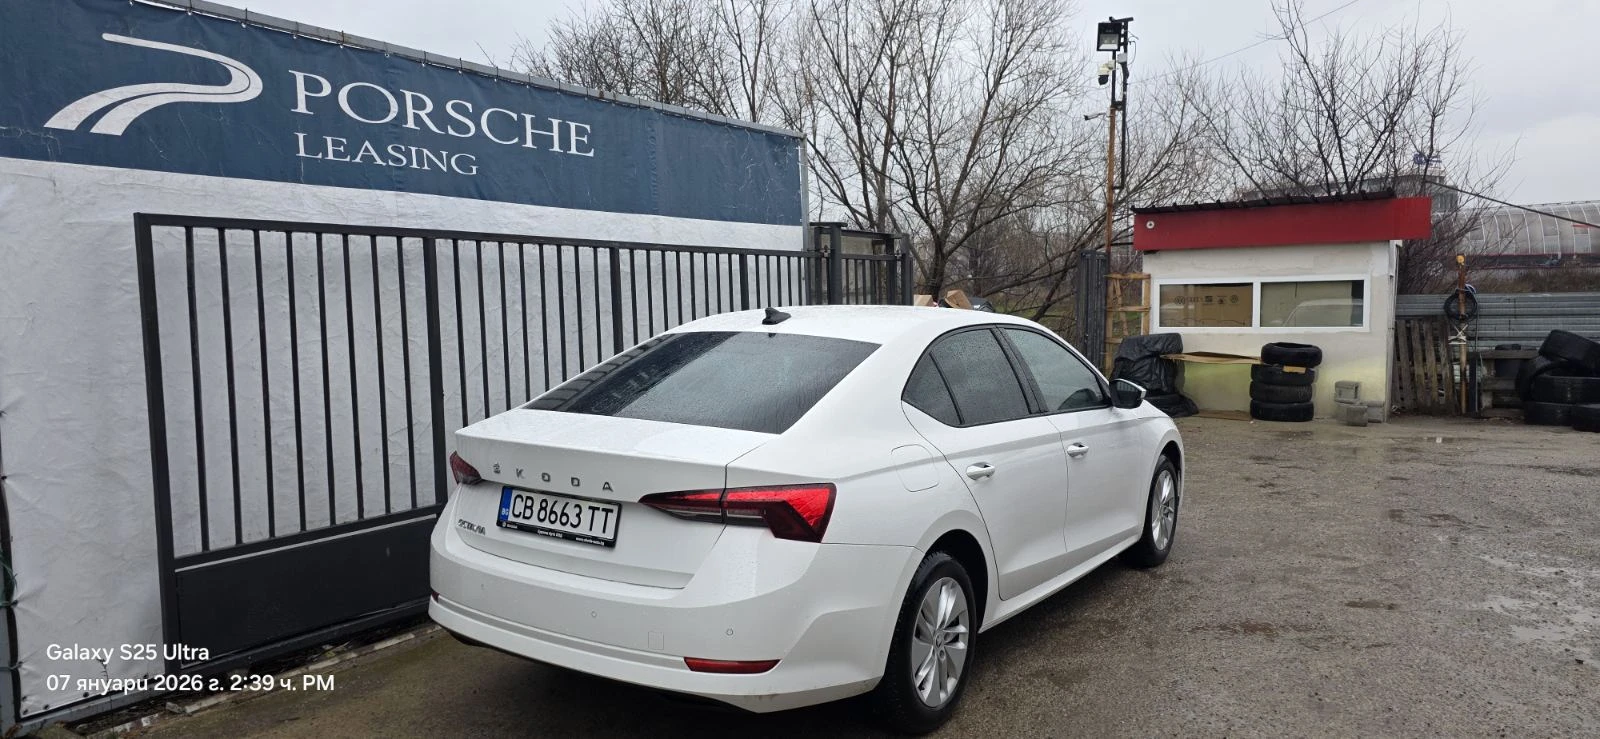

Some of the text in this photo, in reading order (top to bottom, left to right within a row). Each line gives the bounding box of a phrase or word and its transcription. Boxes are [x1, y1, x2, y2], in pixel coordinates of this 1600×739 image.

[288, 69, 596, 158] PORSCHE
[294, 132, 479, 176] LEASING
[501, 507, 510, 516] BG
[512, 493, 614, 534] CB 8663 TT
